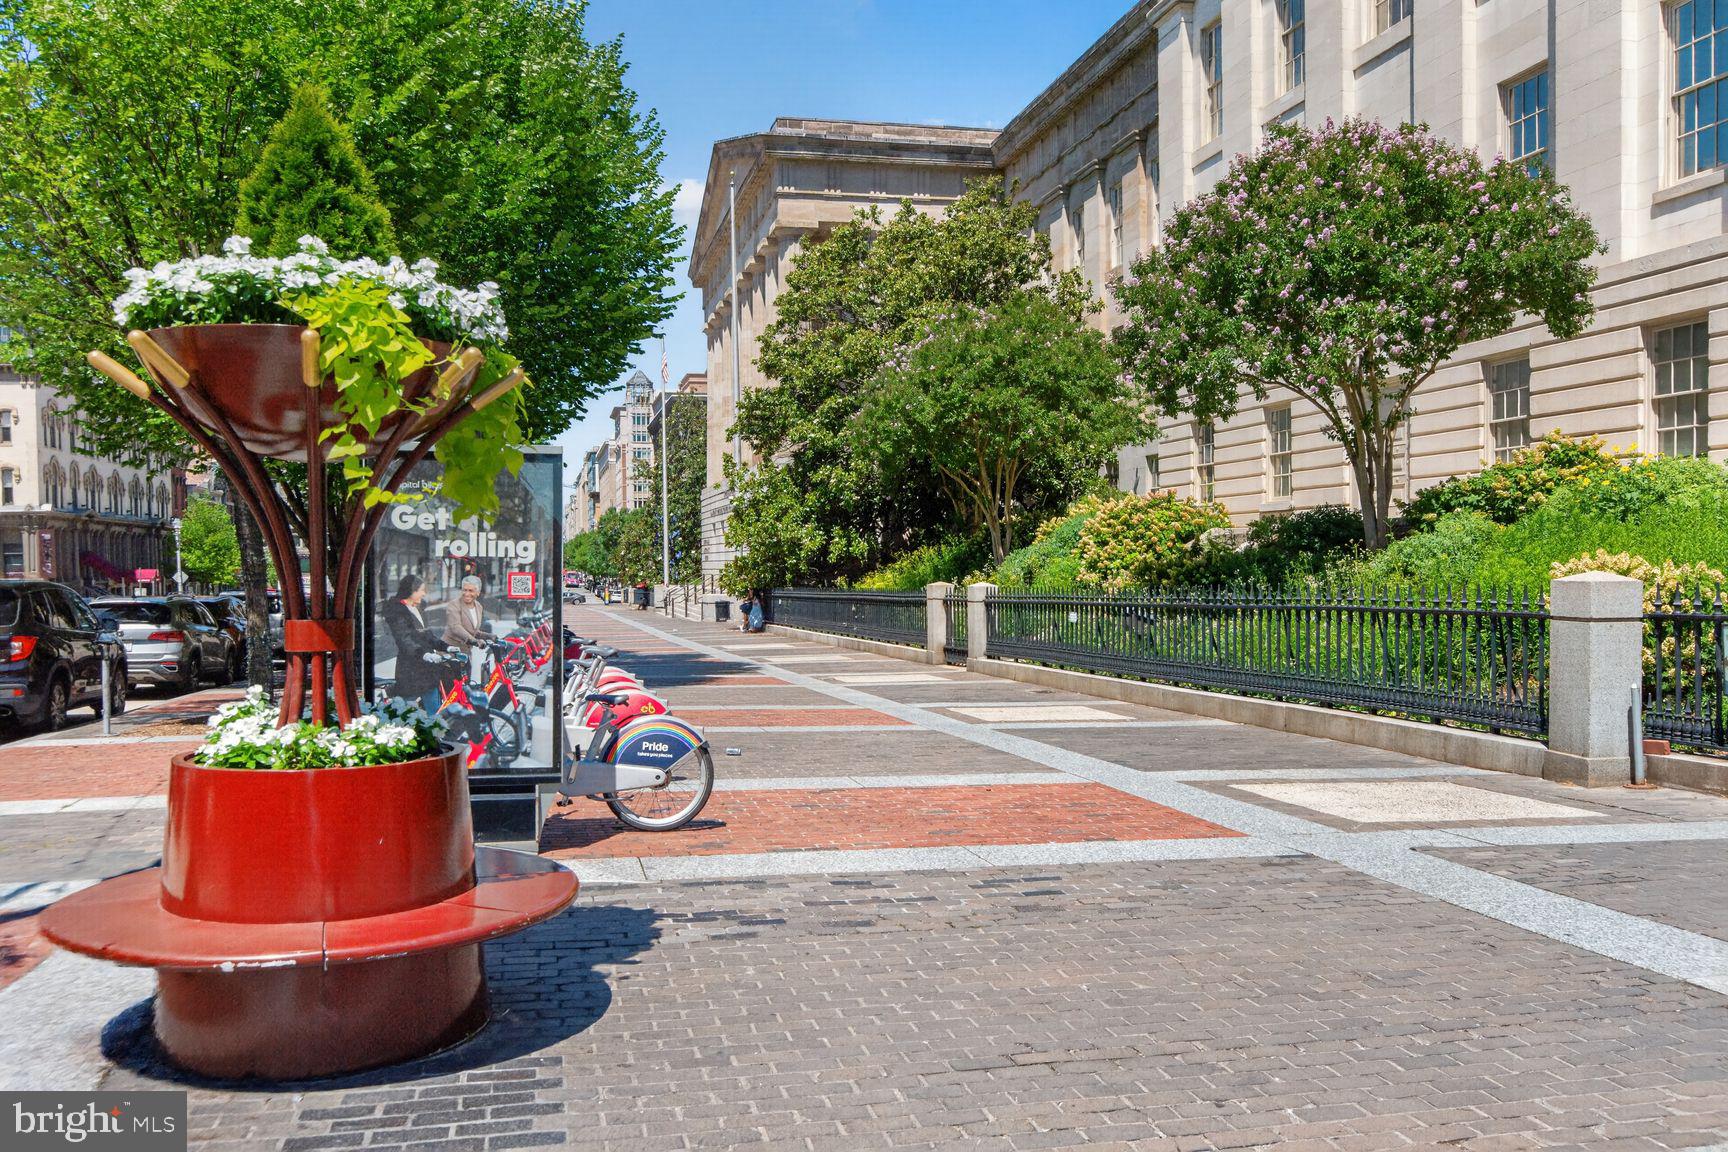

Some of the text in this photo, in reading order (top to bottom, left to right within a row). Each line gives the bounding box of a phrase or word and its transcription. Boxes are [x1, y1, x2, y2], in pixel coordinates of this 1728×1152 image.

[391, 504, 450, 531] Get
[435, 531, 536, 564] rolling
[640, 702, 656, 713] cb
[642, 741, 669, 752] Pride
